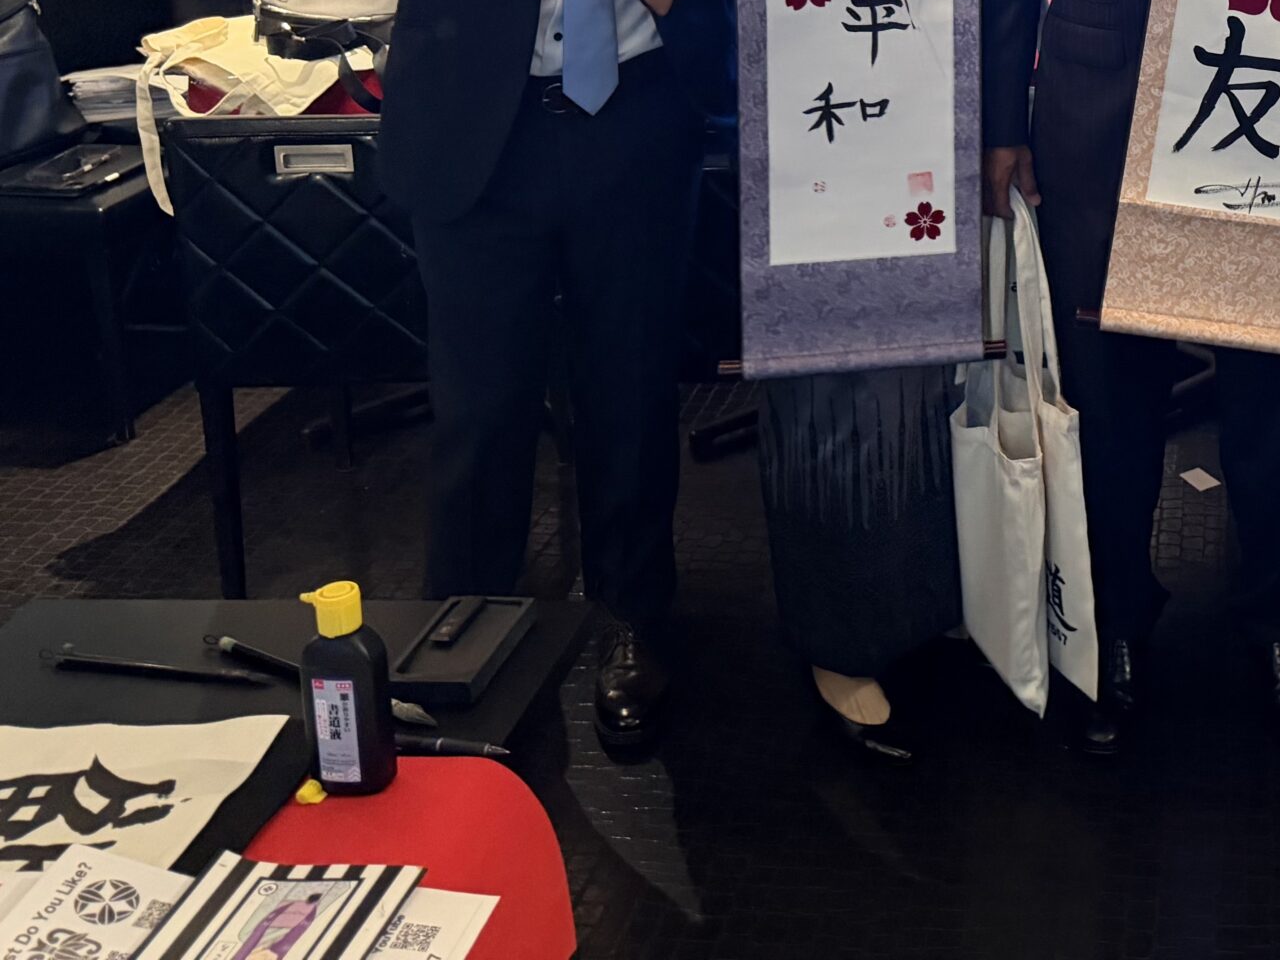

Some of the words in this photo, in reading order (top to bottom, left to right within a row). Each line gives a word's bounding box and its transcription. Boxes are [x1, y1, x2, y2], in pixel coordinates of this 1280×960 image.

[14, 925, 39, 946] Do
[32, 898, 64, 922] You
[56, 861, 94, 897] Like?
